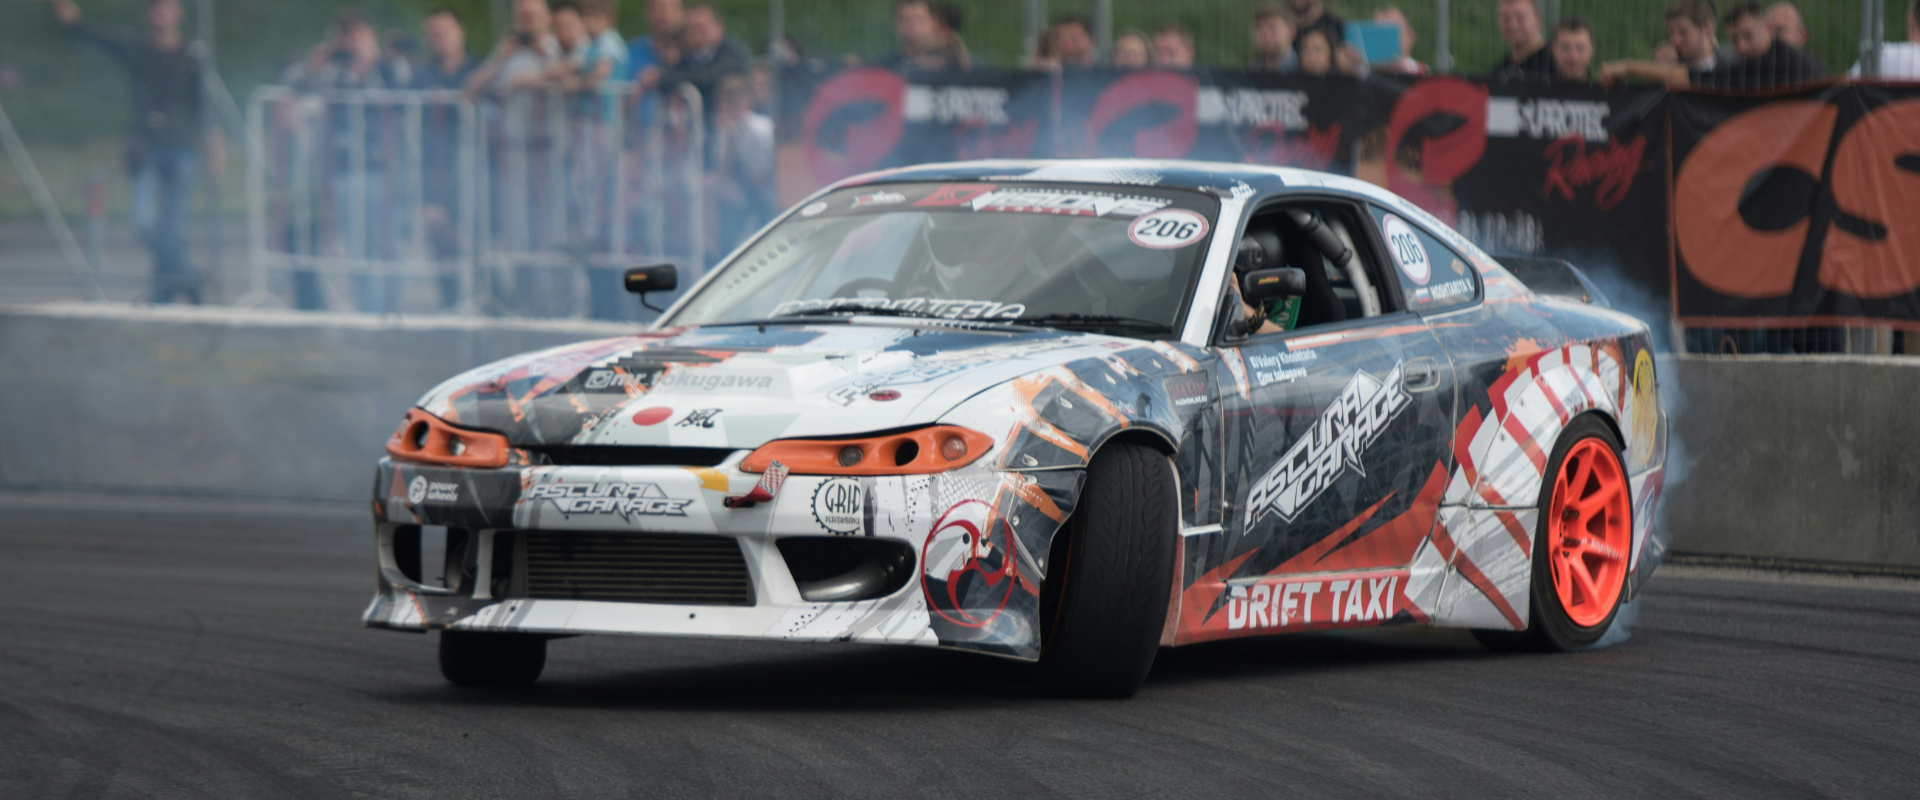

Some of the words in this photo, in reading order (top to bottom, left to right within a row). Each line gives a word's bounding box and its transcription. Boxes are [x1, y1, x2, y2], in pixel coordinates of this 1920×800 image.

[1137, 218, 1198, 240] 206
[1391, 233, 1424, 265] 206
[1171, 380, 1206, 398] MAXIM
[1296, 360, 1408, 512] GARAGE
[1244, 374, 1370, 534] ASCURA
[427, 491, 458, 501] wheels
[429, 482, 459, 491] power
[529, 483, 645, 500] ASCURA
[825, 483, 860, 514] GRID
[569, 498, 694, 523] GARAGE
[1228, 580, 1322, 630] DRIFT
[1329, 576, 1398, 622] TAXI
